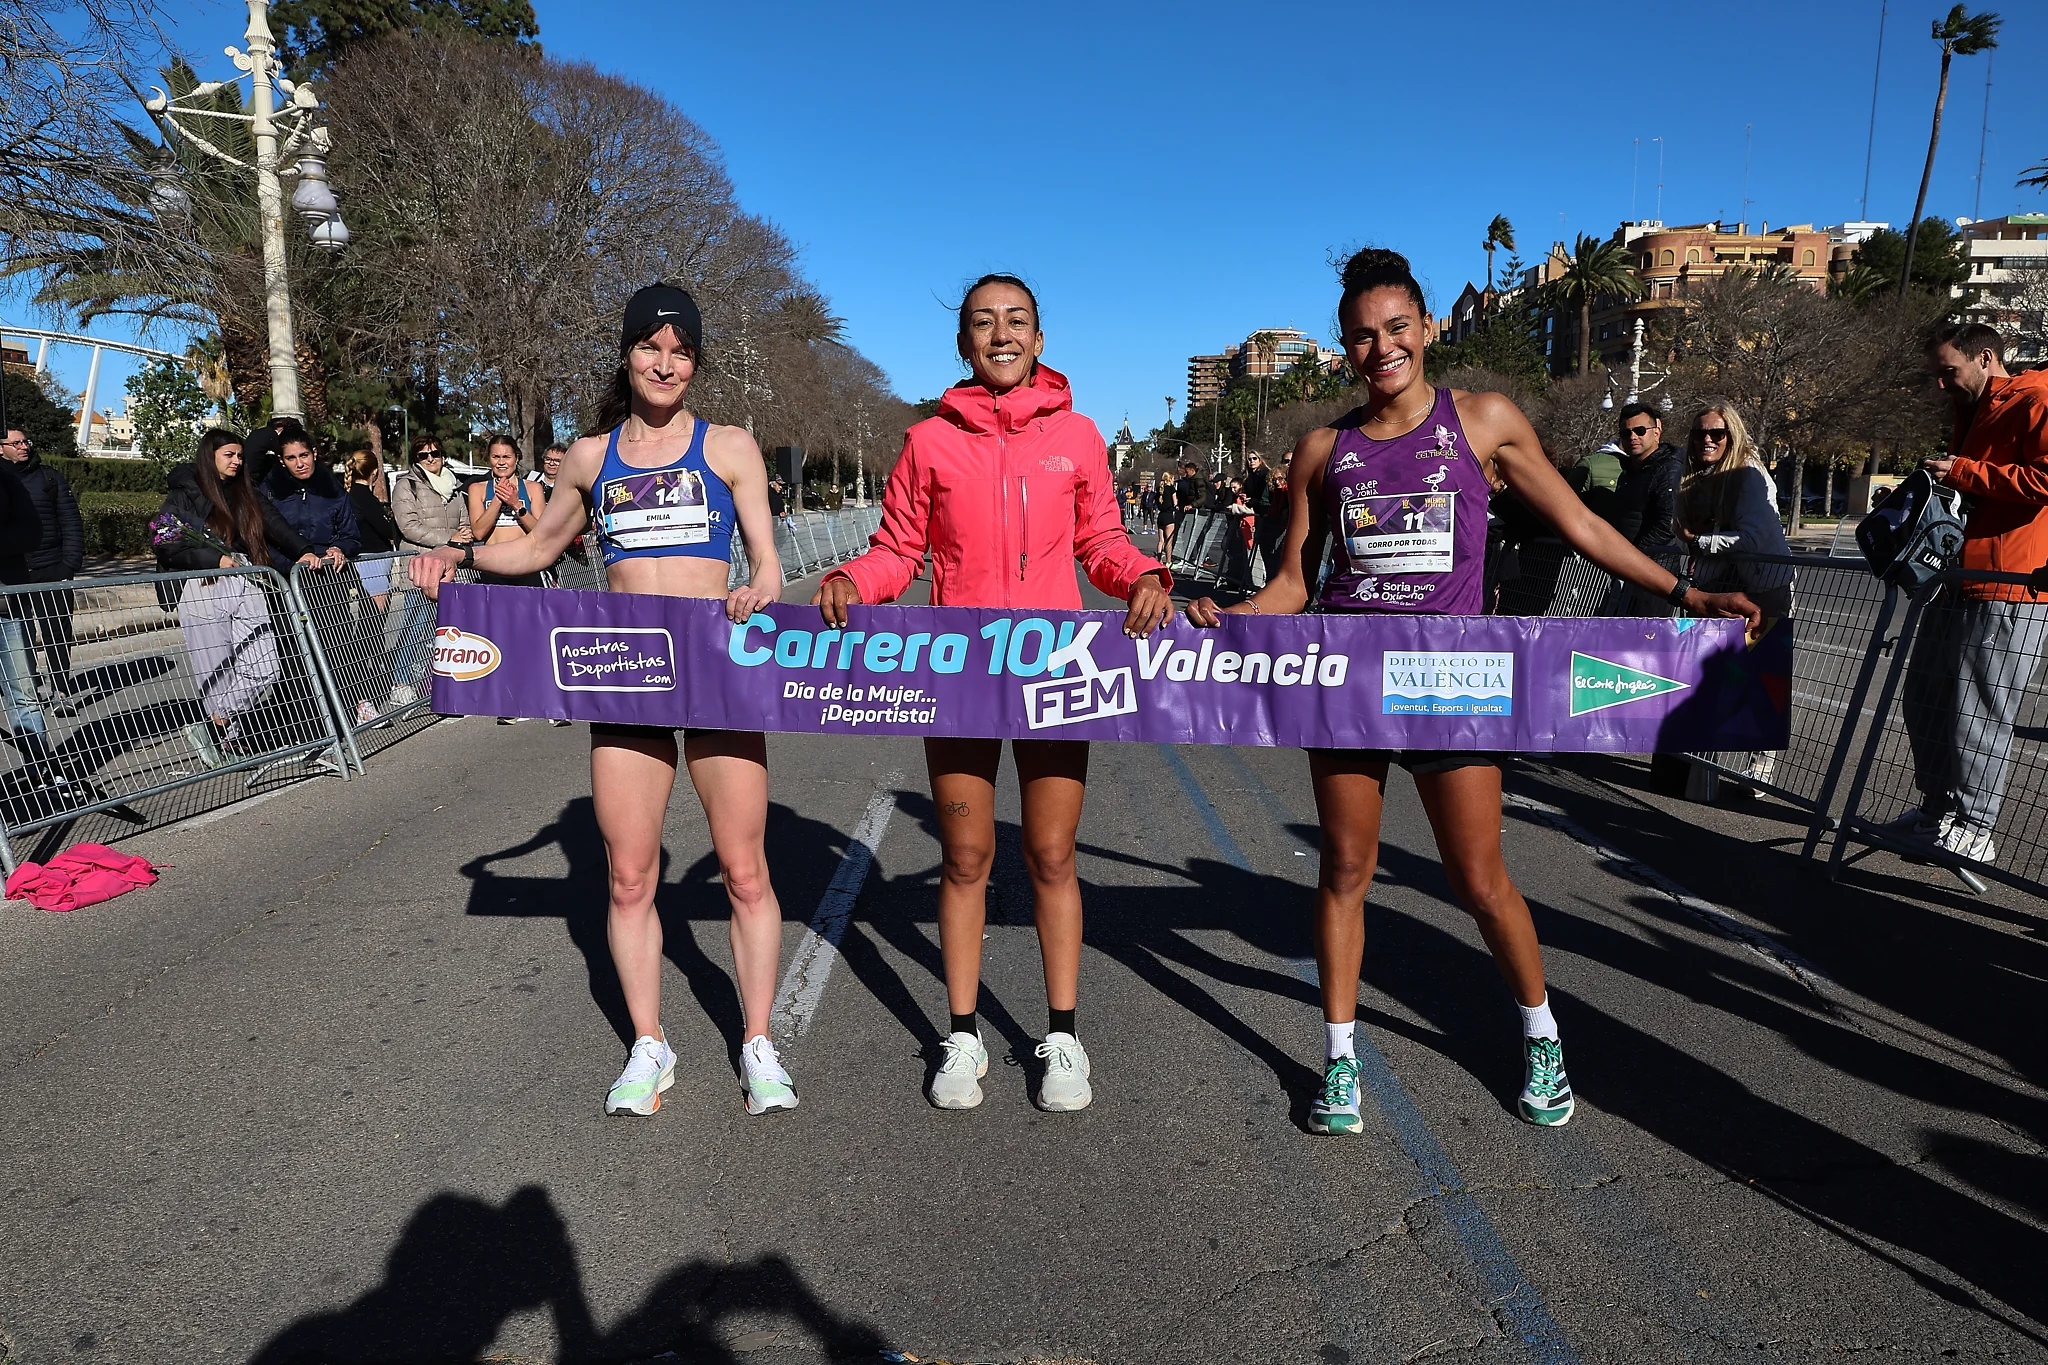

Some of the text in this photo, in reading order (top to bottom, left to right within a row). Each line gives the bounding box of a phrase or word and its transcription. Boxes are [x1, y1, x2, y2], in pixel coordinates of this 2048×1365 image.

[656, 487, 681, 506] 14
[646, 513, 671, 522] EMILIA
[1402, 512, 1425, 531] 11
[1367, 538, 1438, 549] CORRO POR TODAS
[1382, 581, 1436, 593] Soria puro
[434, 647, 491, 665] errano
[728, 613, 1349, 687] Carrera 10K Valencia
[566, 653, 666, 679] Deportistas
[1389, 656, 1506, 667] DIPUTACIÓ DE
[641, 674, 671, 685] .com
[1389, 670, 1506, 689] VALÈNCIA
[783, 681, 937, 706] Día de la Mujer...
[1033, 678, 1127, 724] FEM
[820, 705, 937, 726] ¡Deportista!
[1390, 702, 1430, 714] Joventut,
[1432, 703, 1464, 715] Esports
[1470, 703, 1503, 714] Igualtat
